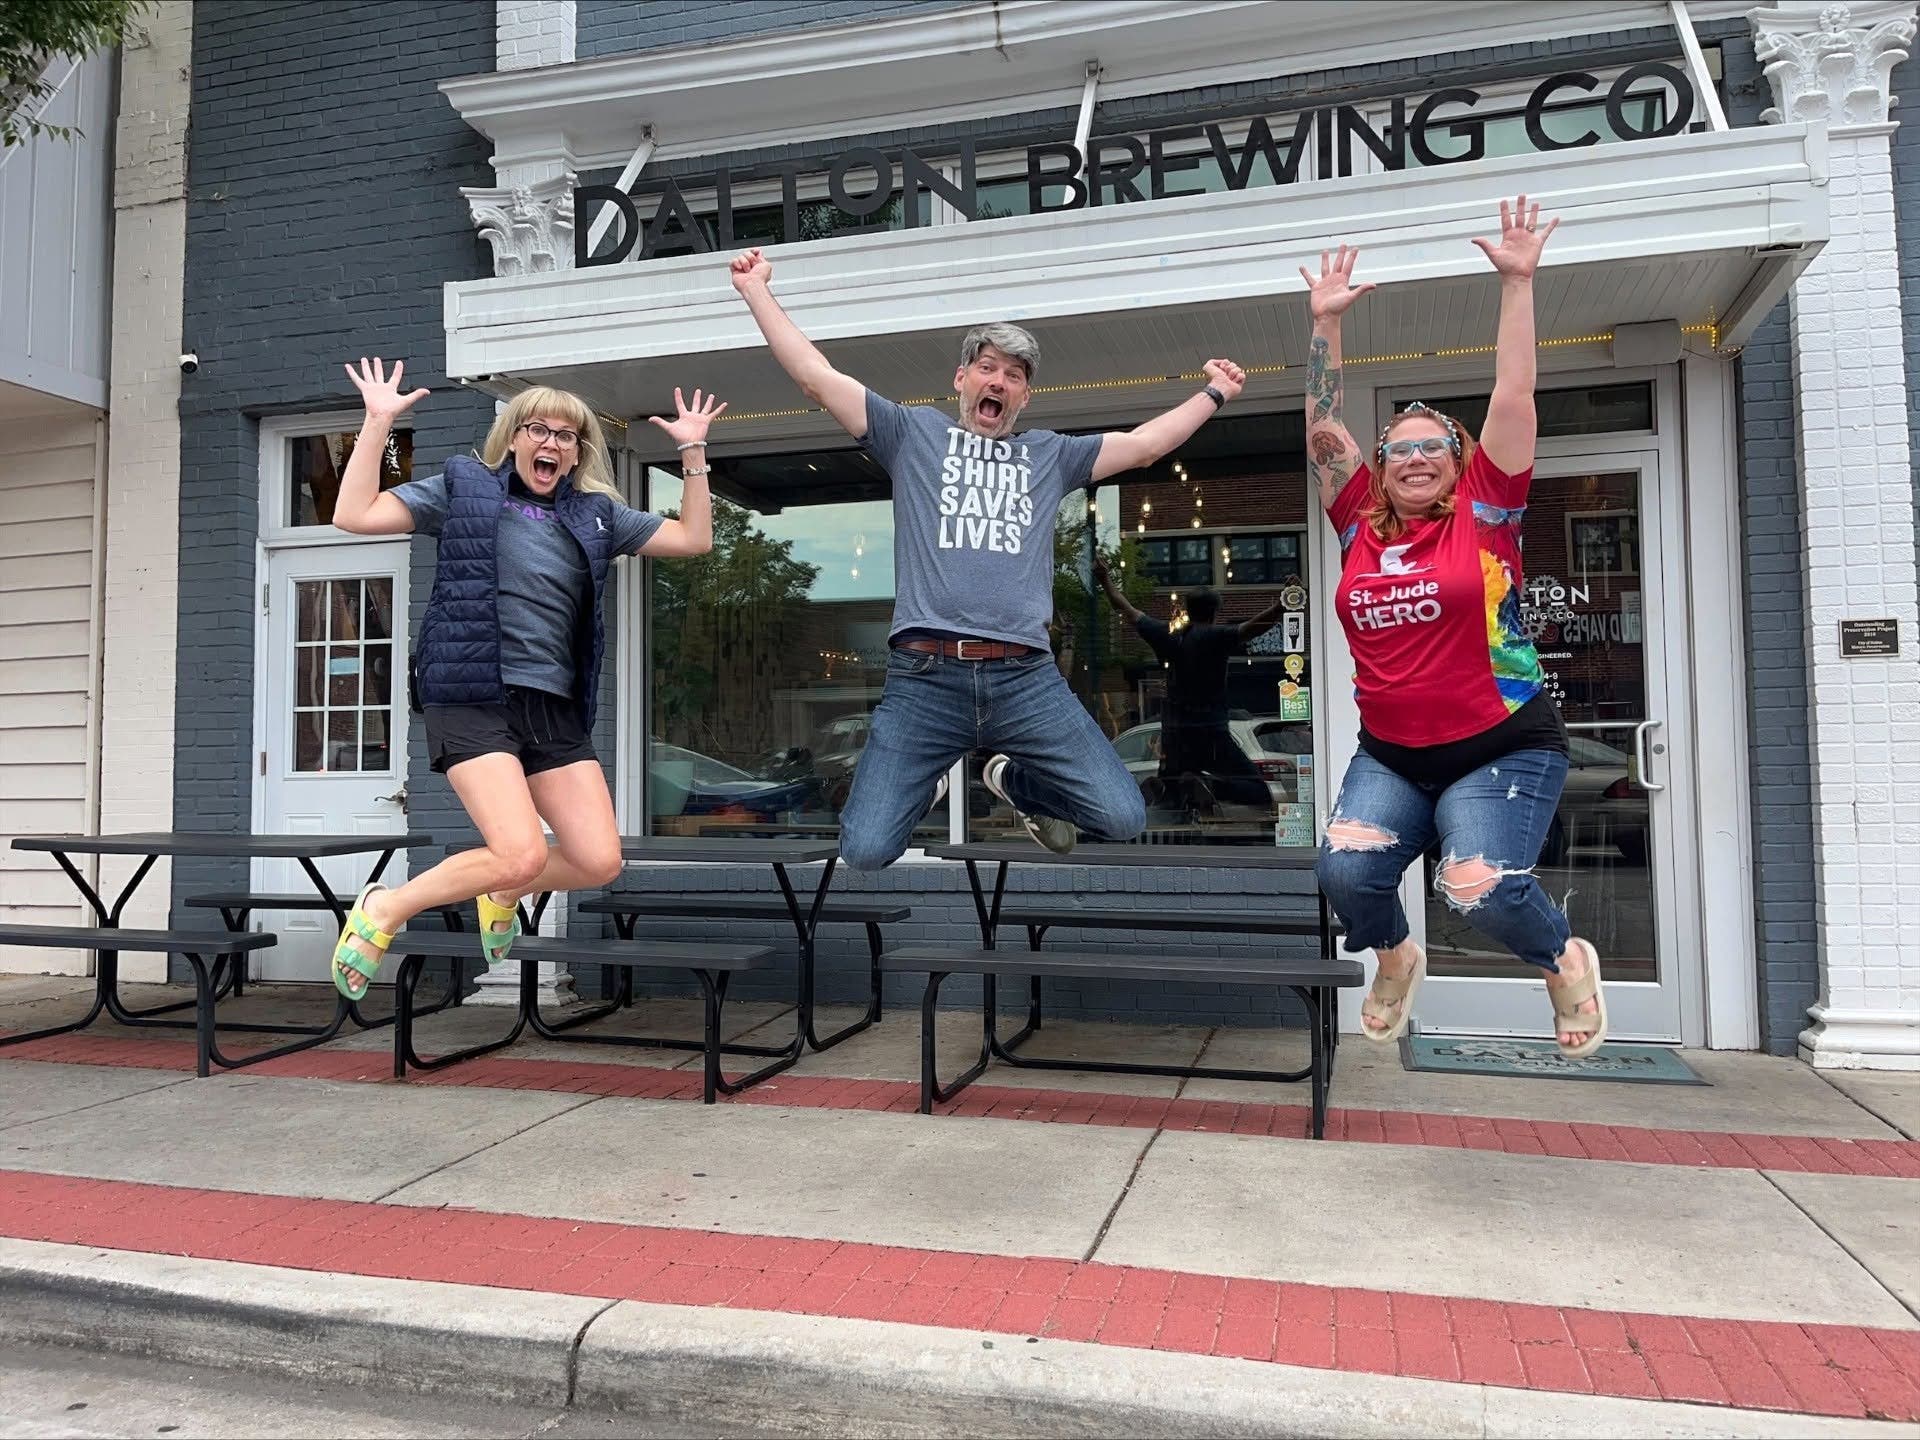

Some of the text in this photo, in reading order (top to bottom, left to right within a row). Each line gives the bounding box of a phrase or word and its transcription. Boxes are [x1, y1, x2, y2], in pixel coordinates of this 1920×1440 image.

[573, 134, 977, 268] DALTON
[1027, 88, 1486, 215] BREWING
[947, 427, 1012, 461] THIS
[941, 456, 1031, 494] SHIRT
[939, 485, 1033, 526] SAVES
[938, 516, 1021, 555] LIVES
[1349, 580, 1440, 607] St. Jude
[1351, 599, 1442, 631] HERO
[1284, 699, 1307, 710] Best
